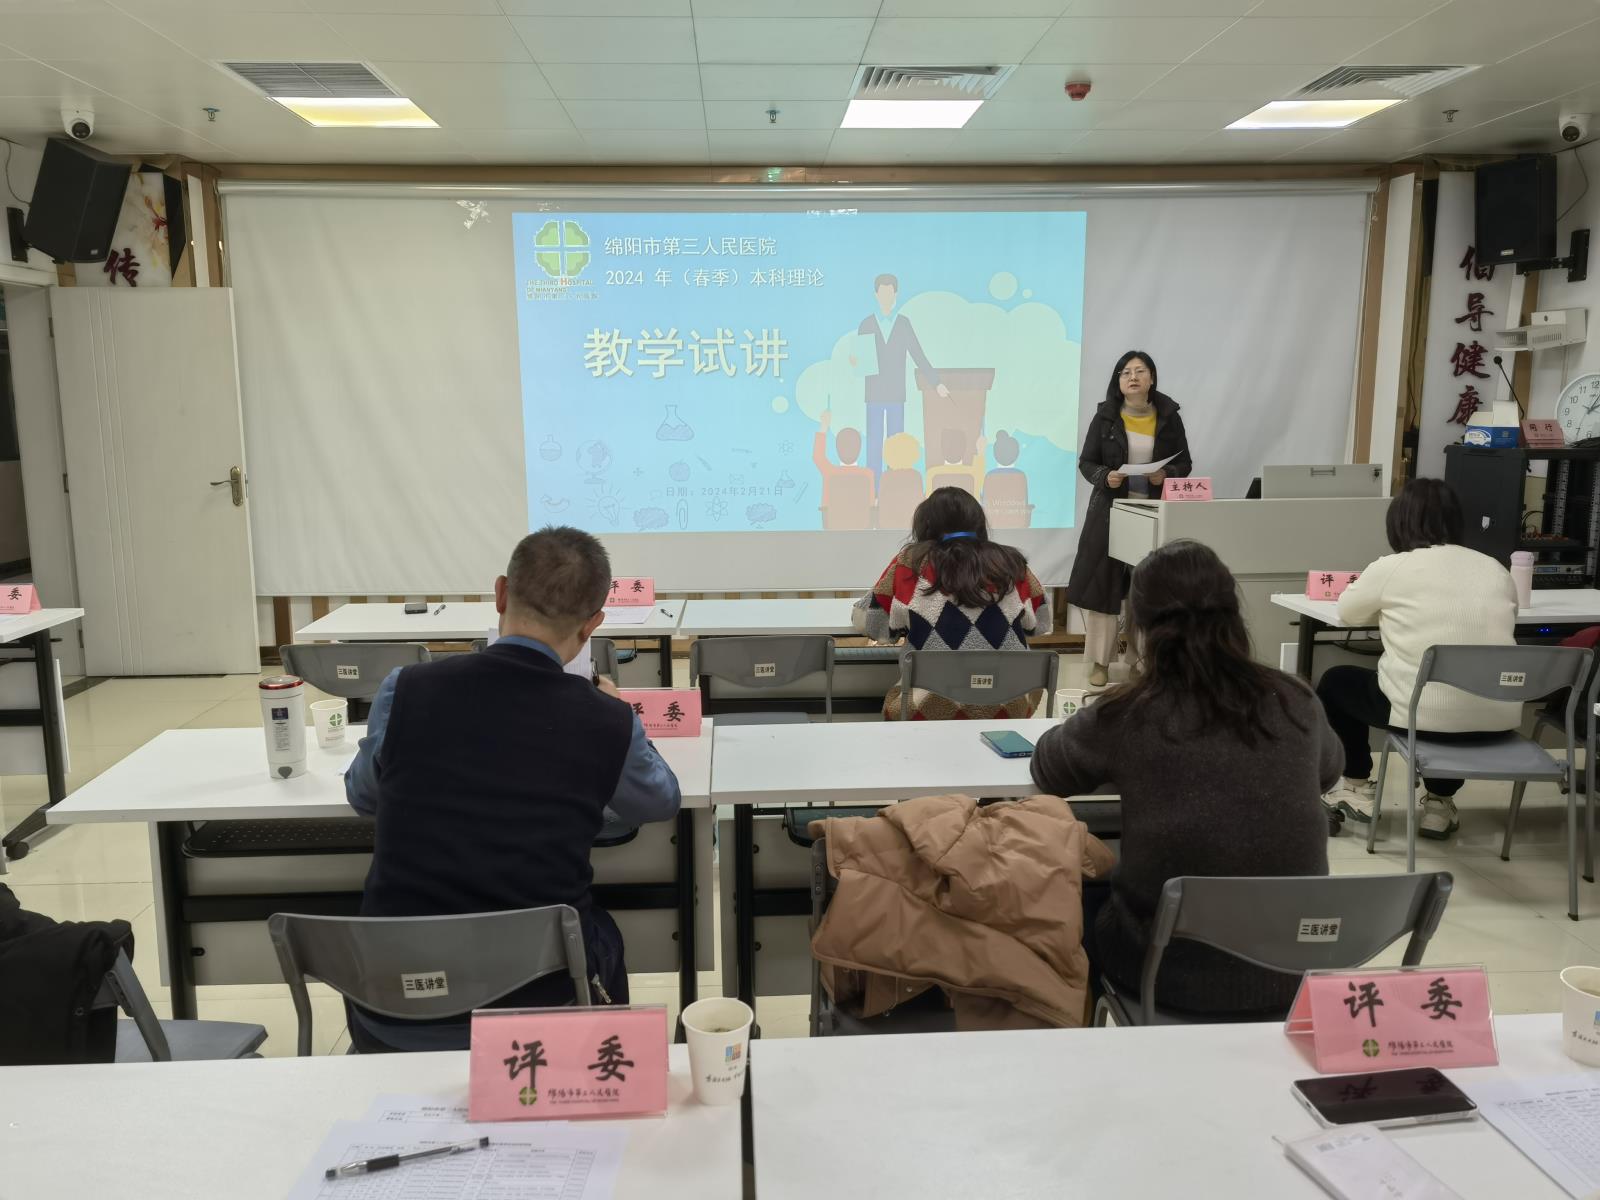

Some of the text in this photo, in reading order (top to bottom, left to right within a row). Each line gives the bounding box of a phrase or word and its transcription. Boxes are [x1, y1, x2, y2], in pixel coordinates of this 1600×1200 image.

[604, 236, 777, 257] 绵阳市第三人民医院
[606, 269, 644, 286] 2024
[583, 327, 789, 378] 教学试讲
[1570, 396, 1578, 404] 10
[1564, 408, 1570, 416] 9
[1567, 420, 1572, 428] 8
[1169, 482, 1208, 492] 主持人
[1300, 924, 1338, 935] 三医讲堂
[405, 977, 445, 990] 三医讲堂
[1343, 977, 1463, 1027] 评委
[504, 1035, 634, 1089] 评委
